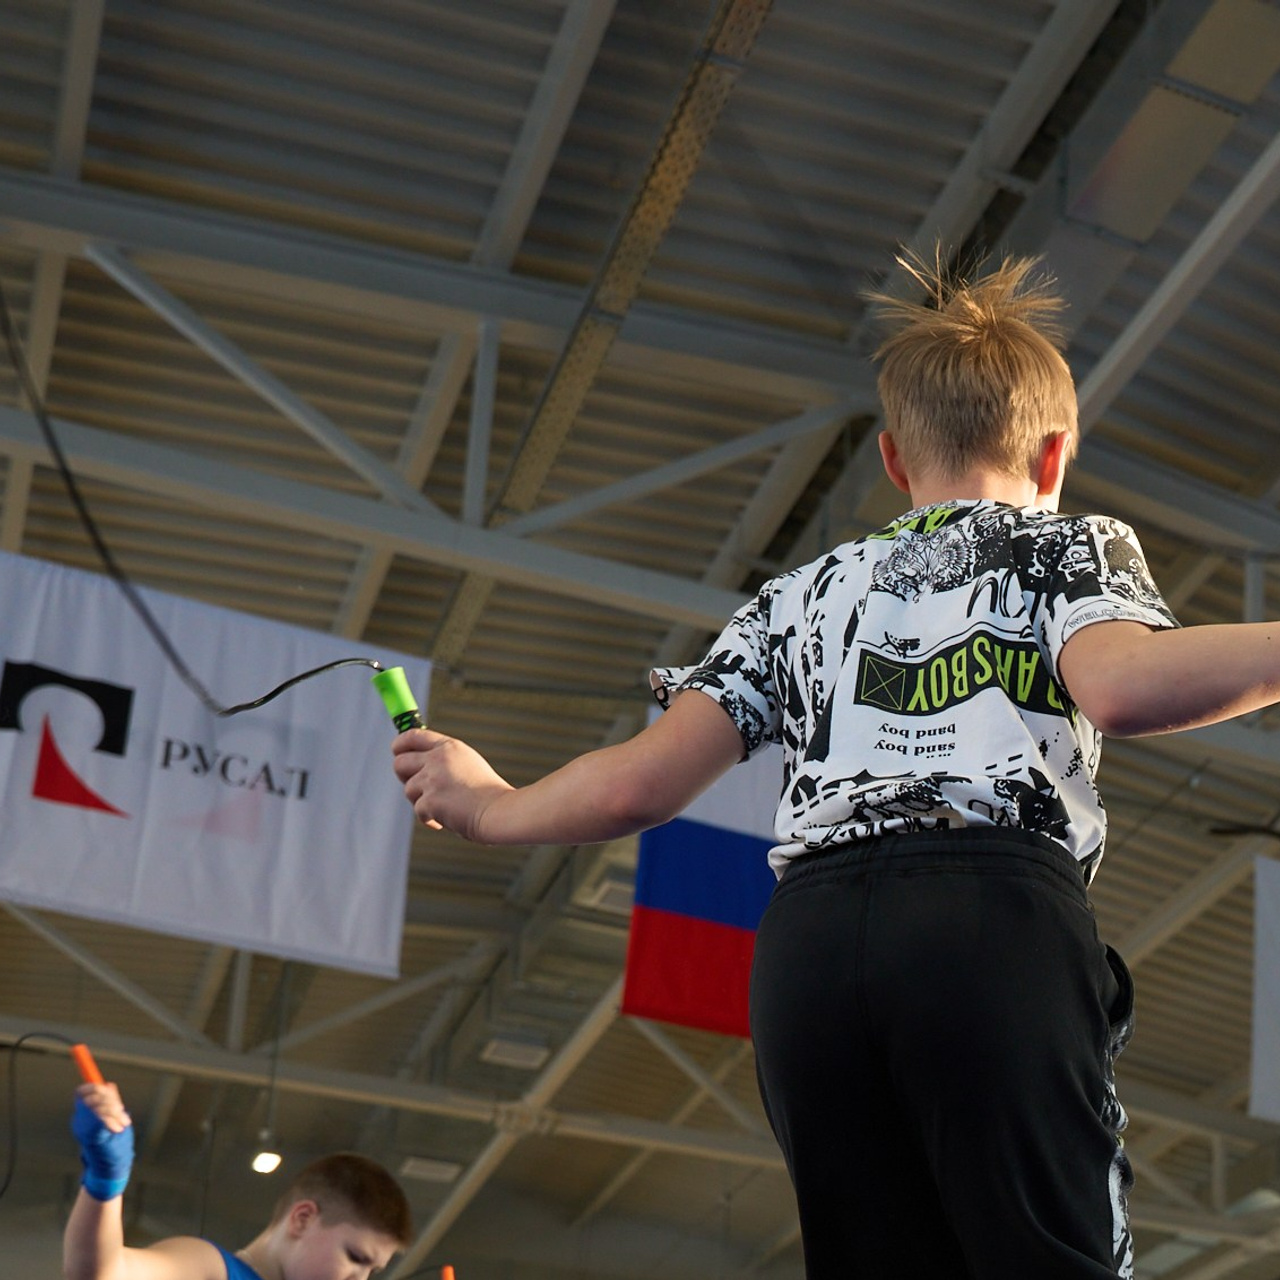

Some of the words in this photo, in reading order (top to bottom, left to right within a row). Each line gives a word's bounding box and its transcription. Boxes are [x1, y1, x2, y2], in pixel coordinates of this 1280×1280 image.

[878, 722, 910, 739] boy
[915, 723, 956, 740] band
[873, 739, 908, 756] boy
[161, 738, 310, 800] РУСАЛ
